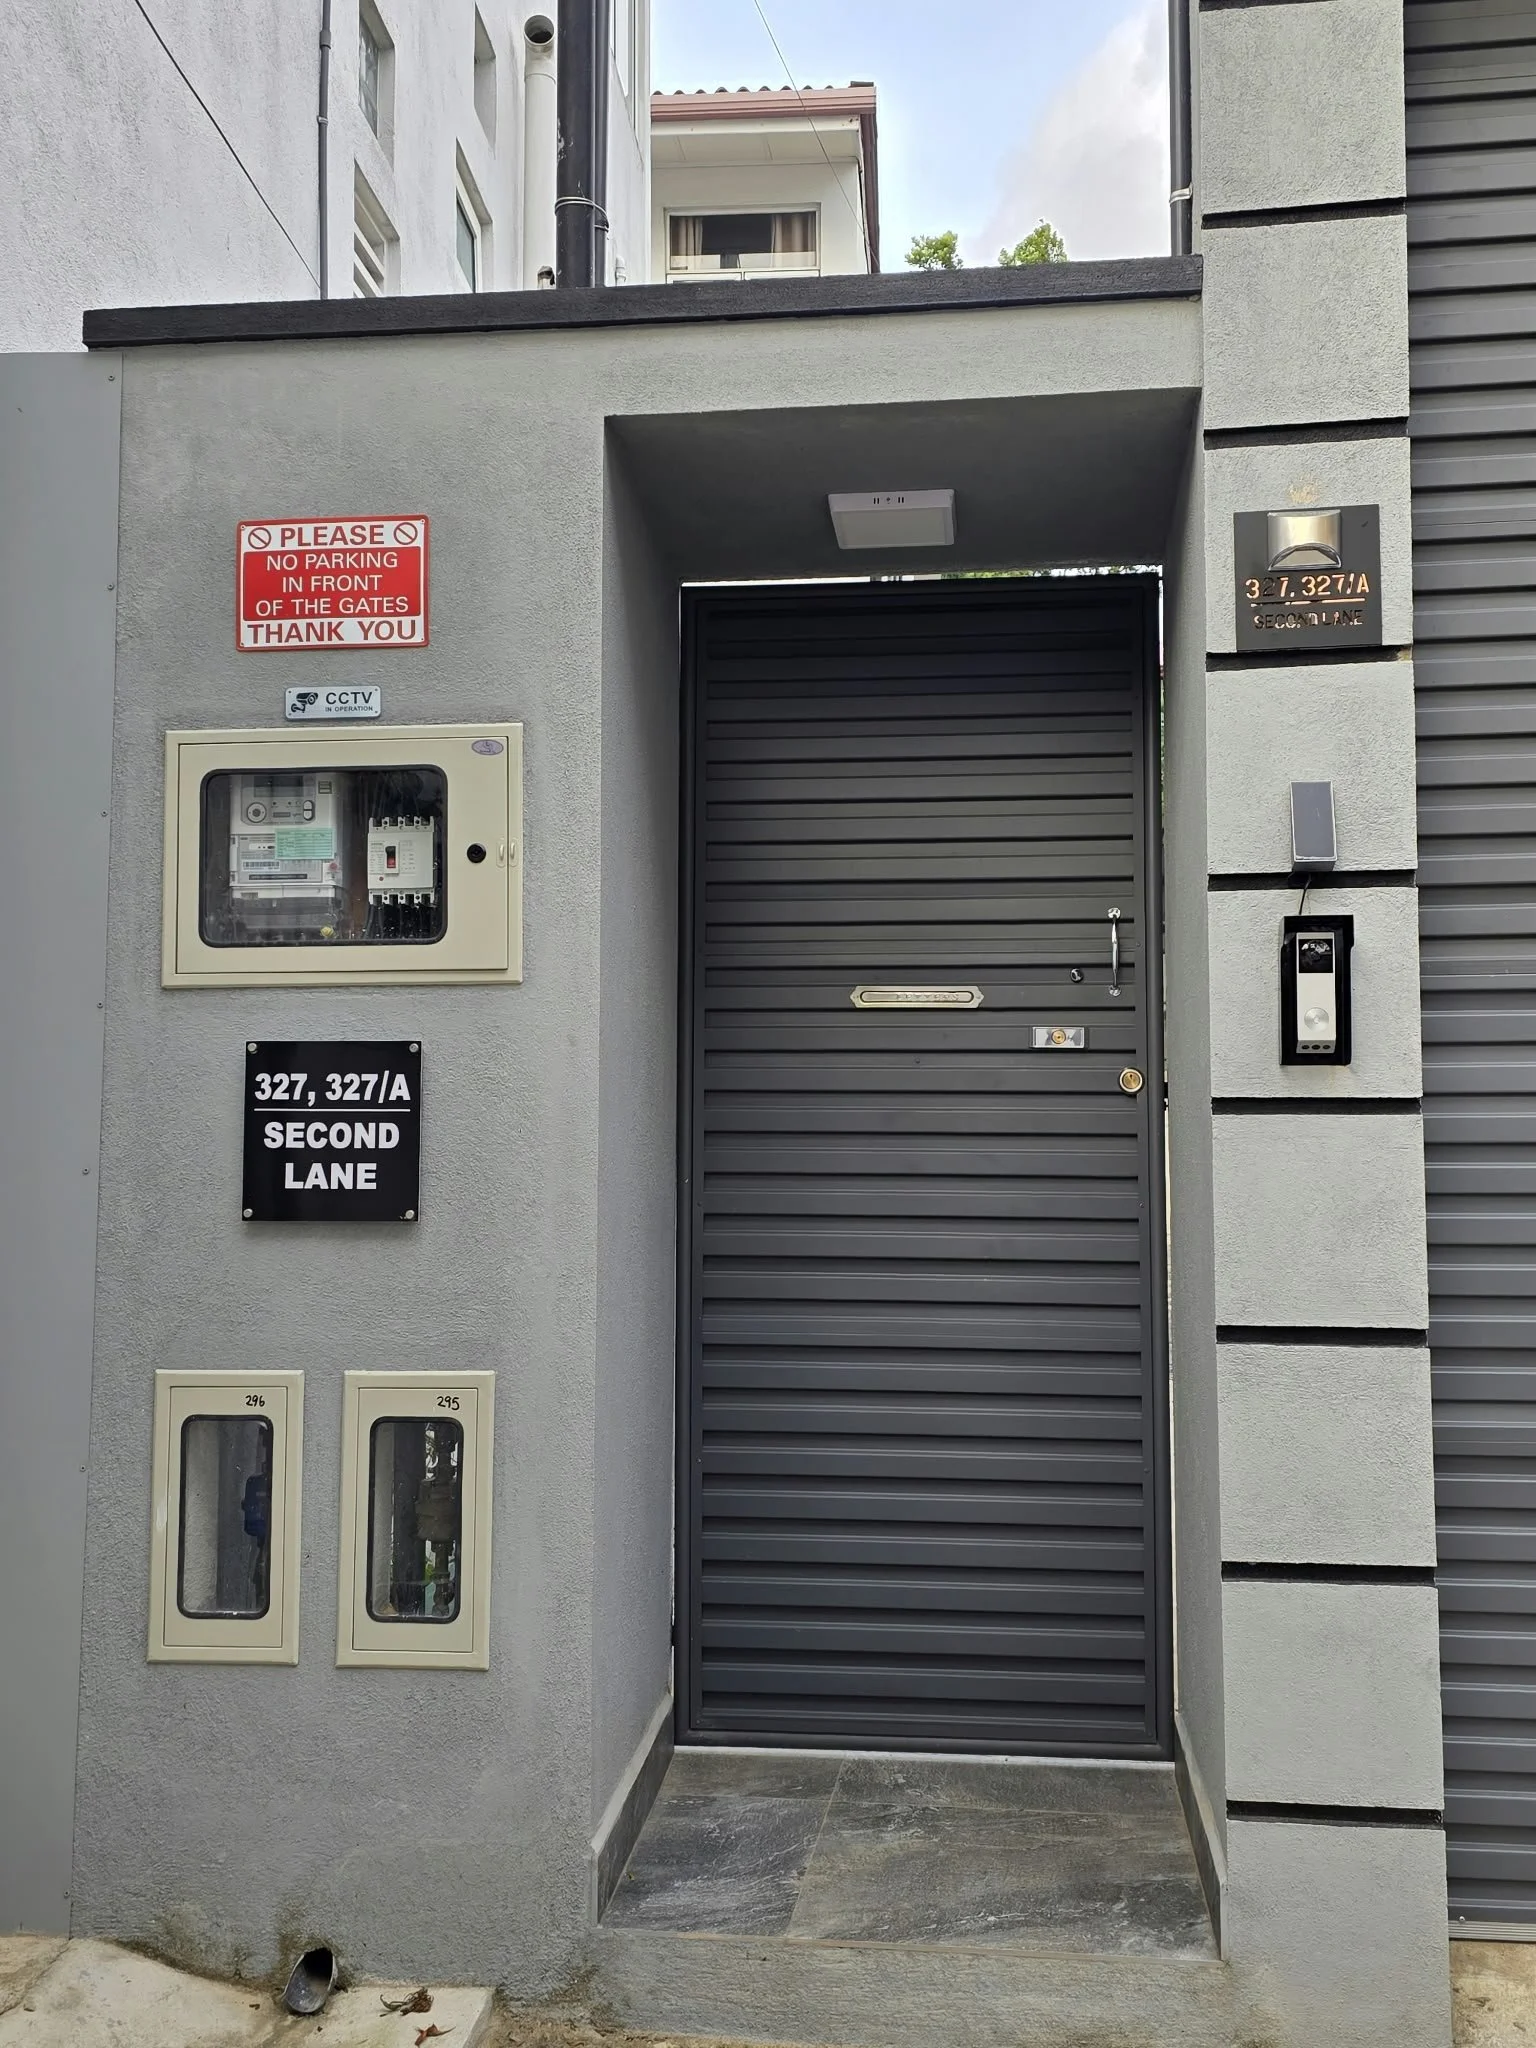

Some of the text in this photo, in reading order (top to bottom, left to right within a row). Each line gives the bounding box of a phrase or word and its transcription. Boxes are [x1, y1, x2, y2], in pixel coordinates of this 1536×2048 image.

[280, 524, 385, 548] PLEASE
[266, 551, 399, 571] NO PARKING
[282, 574, 383, 593] IN FRONT
[1301, 573, 1370, 596] 327/A
[255, 596, 409, 617] OF THE GATES
[1253, 609, 1364, 630] SECOND LANE
[247, 619, 416, 644] THANK YOU
[325, 691, 373, 705] CCTV
[254, 1070, 411, 1108] 327, 327/A
[263, 1121, 400, 1149] SECOND
[284, 1162, 377, 1190] LANE
[245, 1394, 266, 1407] 296
[436, 1395, 460, 1411] 295
